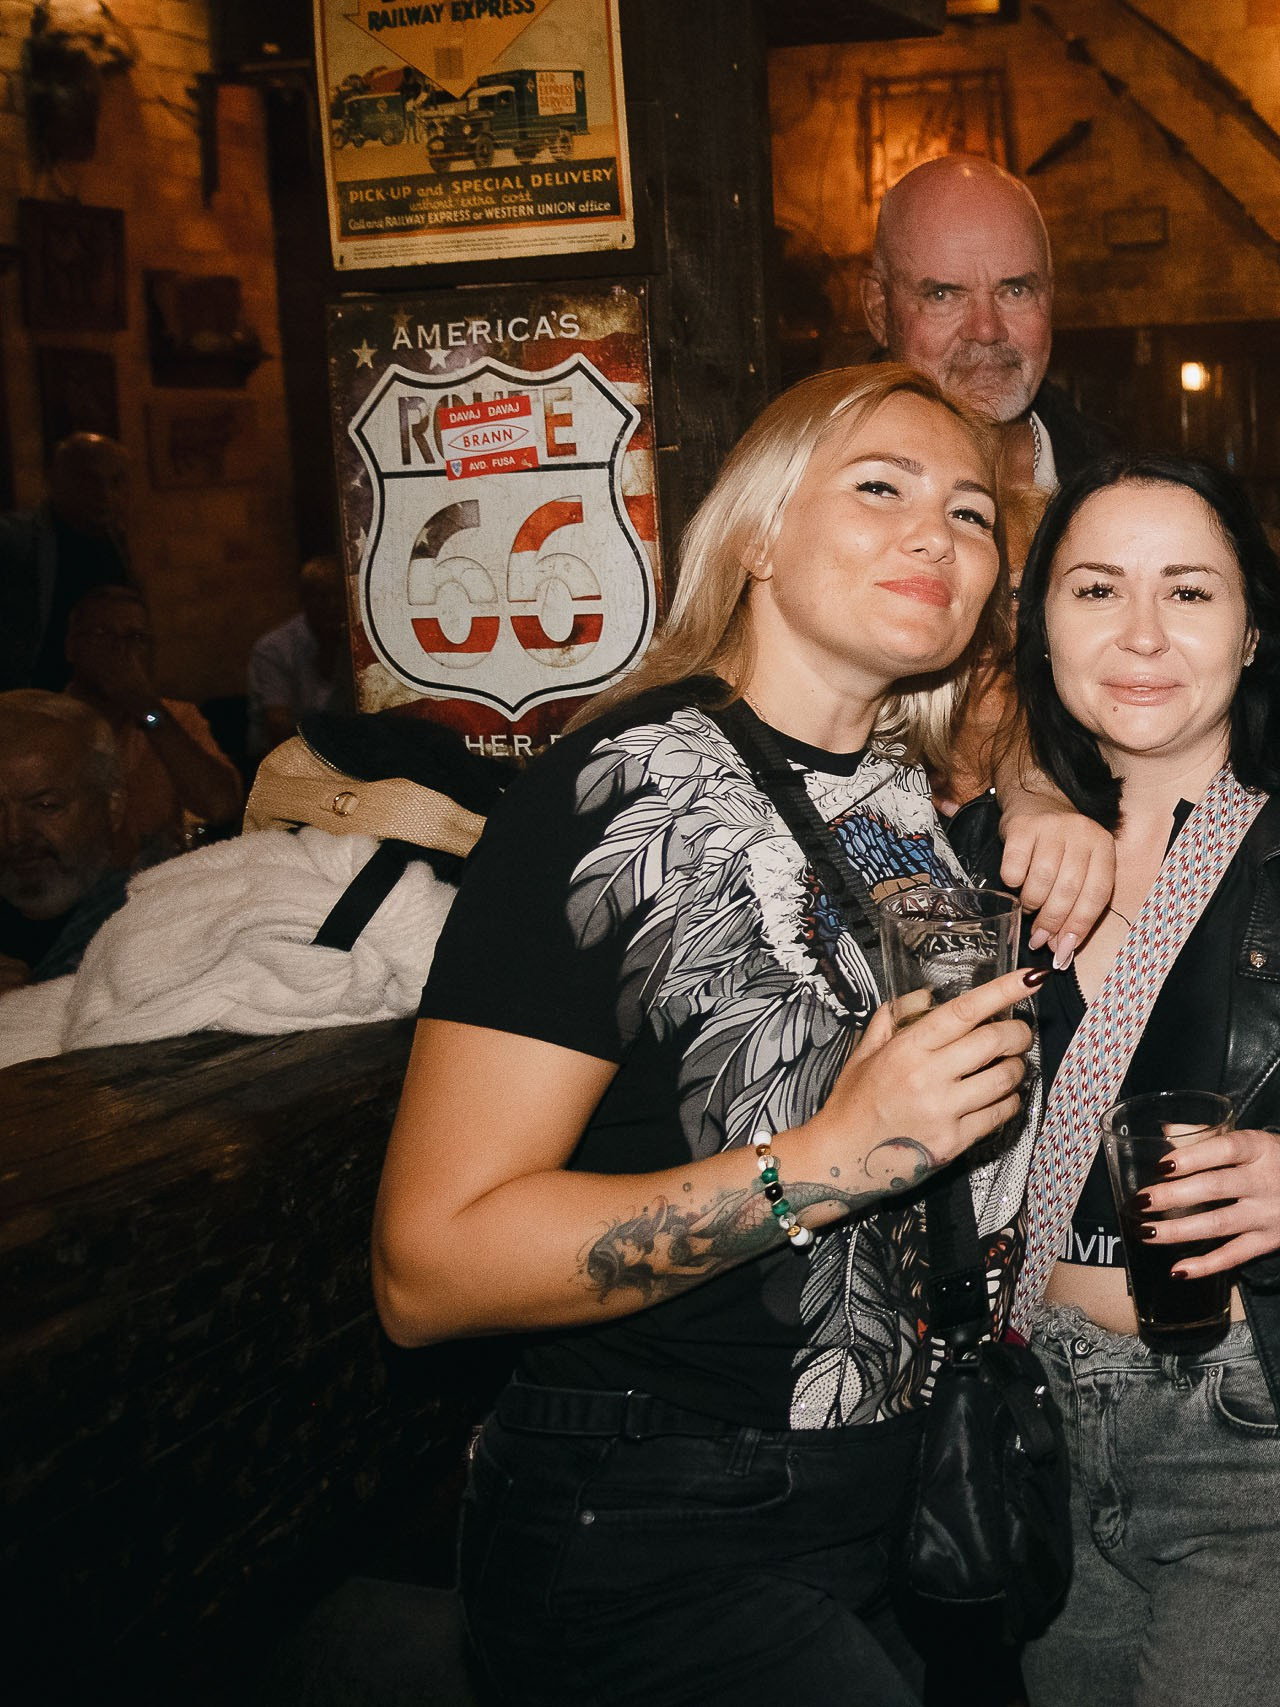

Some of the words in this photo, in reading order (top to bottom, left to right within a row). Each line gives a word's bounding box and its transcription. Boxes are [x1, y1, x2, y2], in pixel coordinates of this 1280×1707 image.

[367, 4, 444, 32] RAILWAY
[450, 0, 535, 22] EXPRESS
[416, 183, 444, 197] and
[451, 176, 524, 194] SPECIAL
[530, 167, 614, 188] DELIVERY
[458, 195, 495, 207] extra
[501, 189, 533, 203] cost
[384, 214, 425, 227] RAILWAY
[427, 208, 471, 224] EXPRESS
[472, 211, 483, 221] or
[484, 204, 535, 219] WESTERN
[537, 201, 576, 216] UNION
[578, 199, 611, 213] office
[392, 311, 580, 350] AMERICA'S
[449, 409, 481, 423] DAVAJ
[487, 402, 520, 417] DAVAJ
[463, 428, 513, 448] BRANN
[492, 456, 516, 468] FUSA
[407, 494, 604, 670] 66
[465, 734, 534, 757] HER
